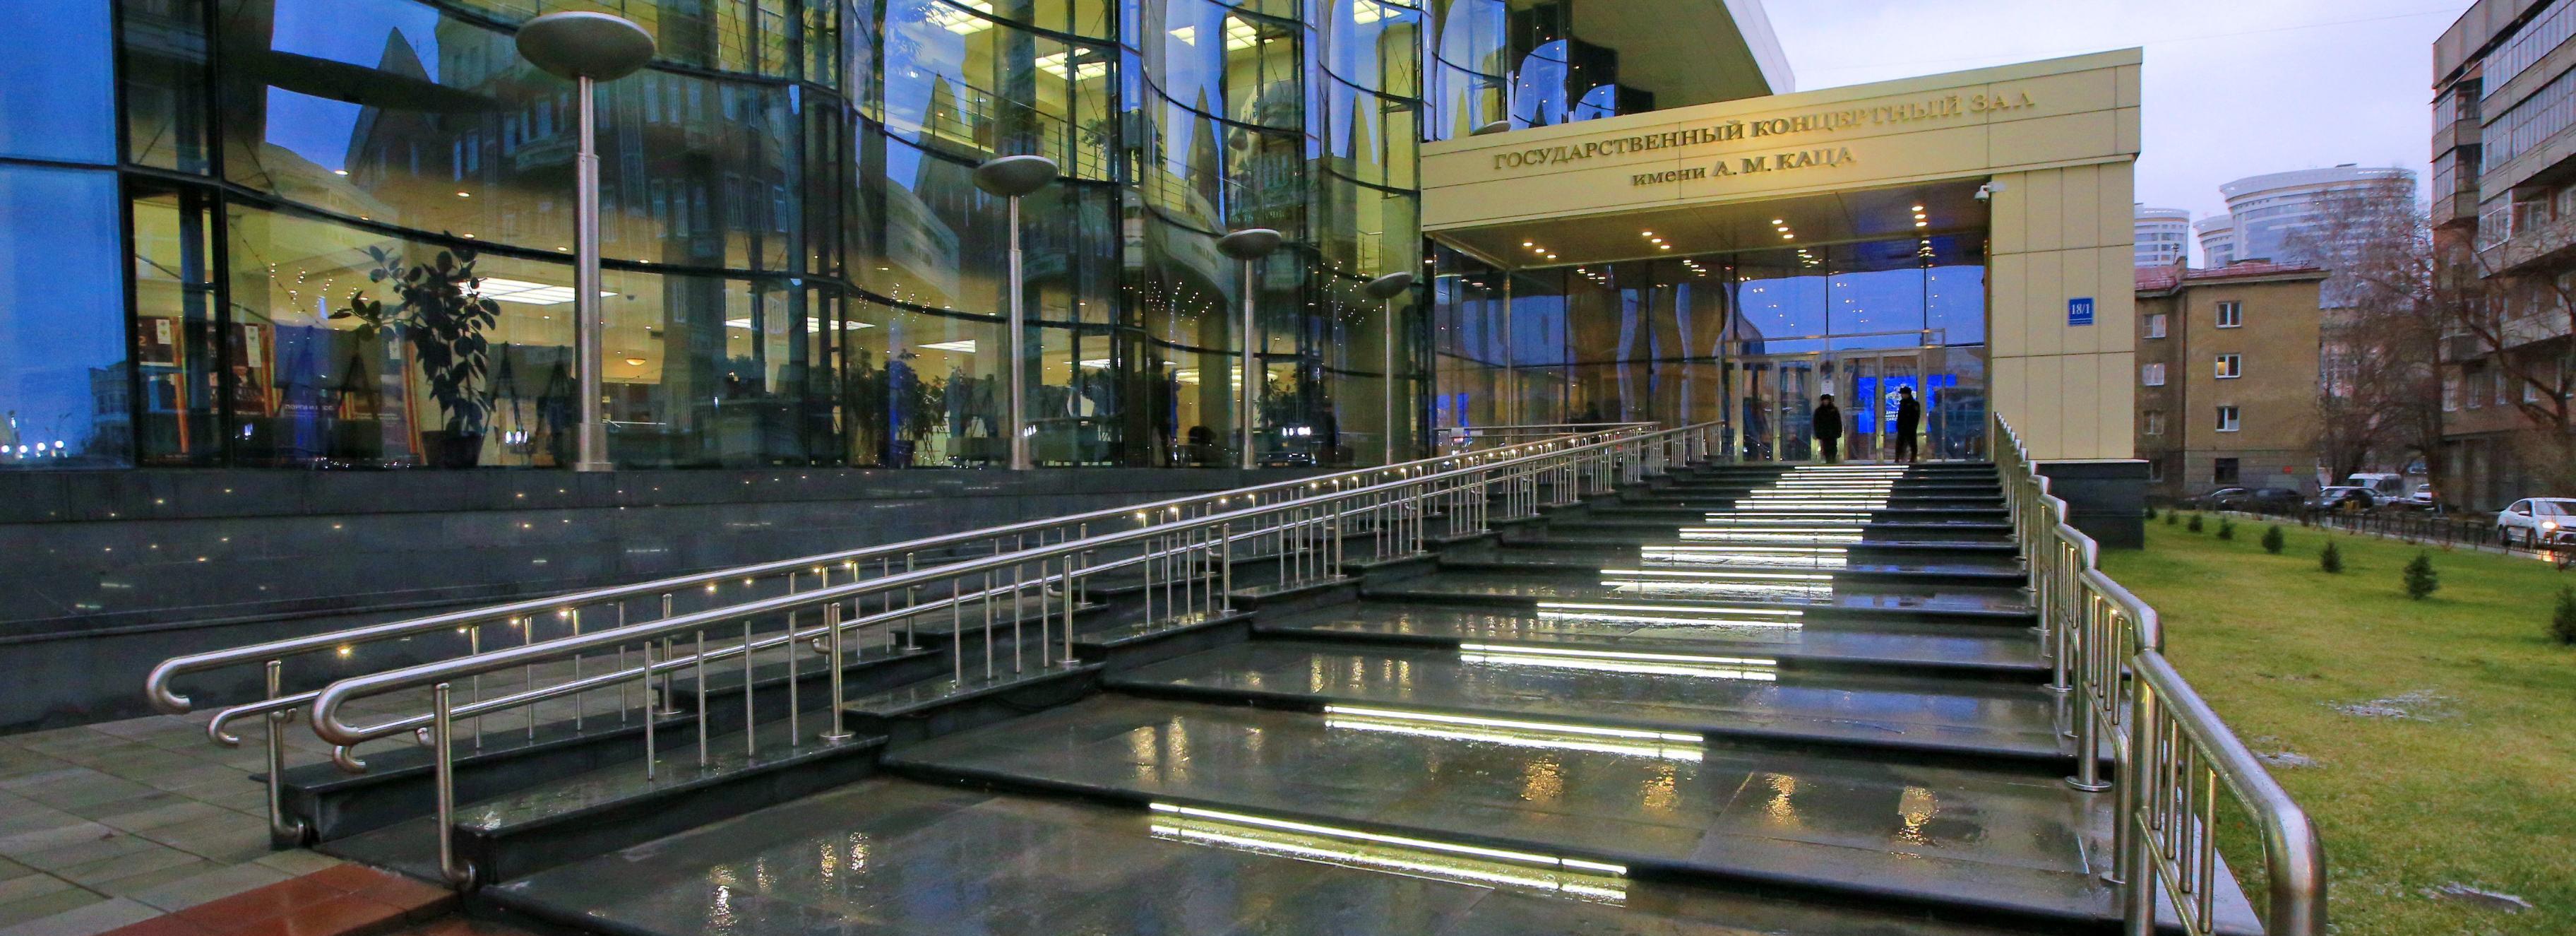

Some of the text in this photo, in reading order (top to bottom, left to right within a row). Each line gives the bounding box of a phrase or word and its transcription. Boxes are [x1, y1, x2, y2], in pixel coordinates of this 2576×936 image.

[1493, 90, 2035, 170] ГОСУДАРСТВЕННЫЙ КОНЦЕРТНЫЙ ЗАЛ
[1633, 167, 1706, 186] имени
[1775, 146, 1856, 170] КАЦА
[2072, 304, 2090, 315] 18/1
